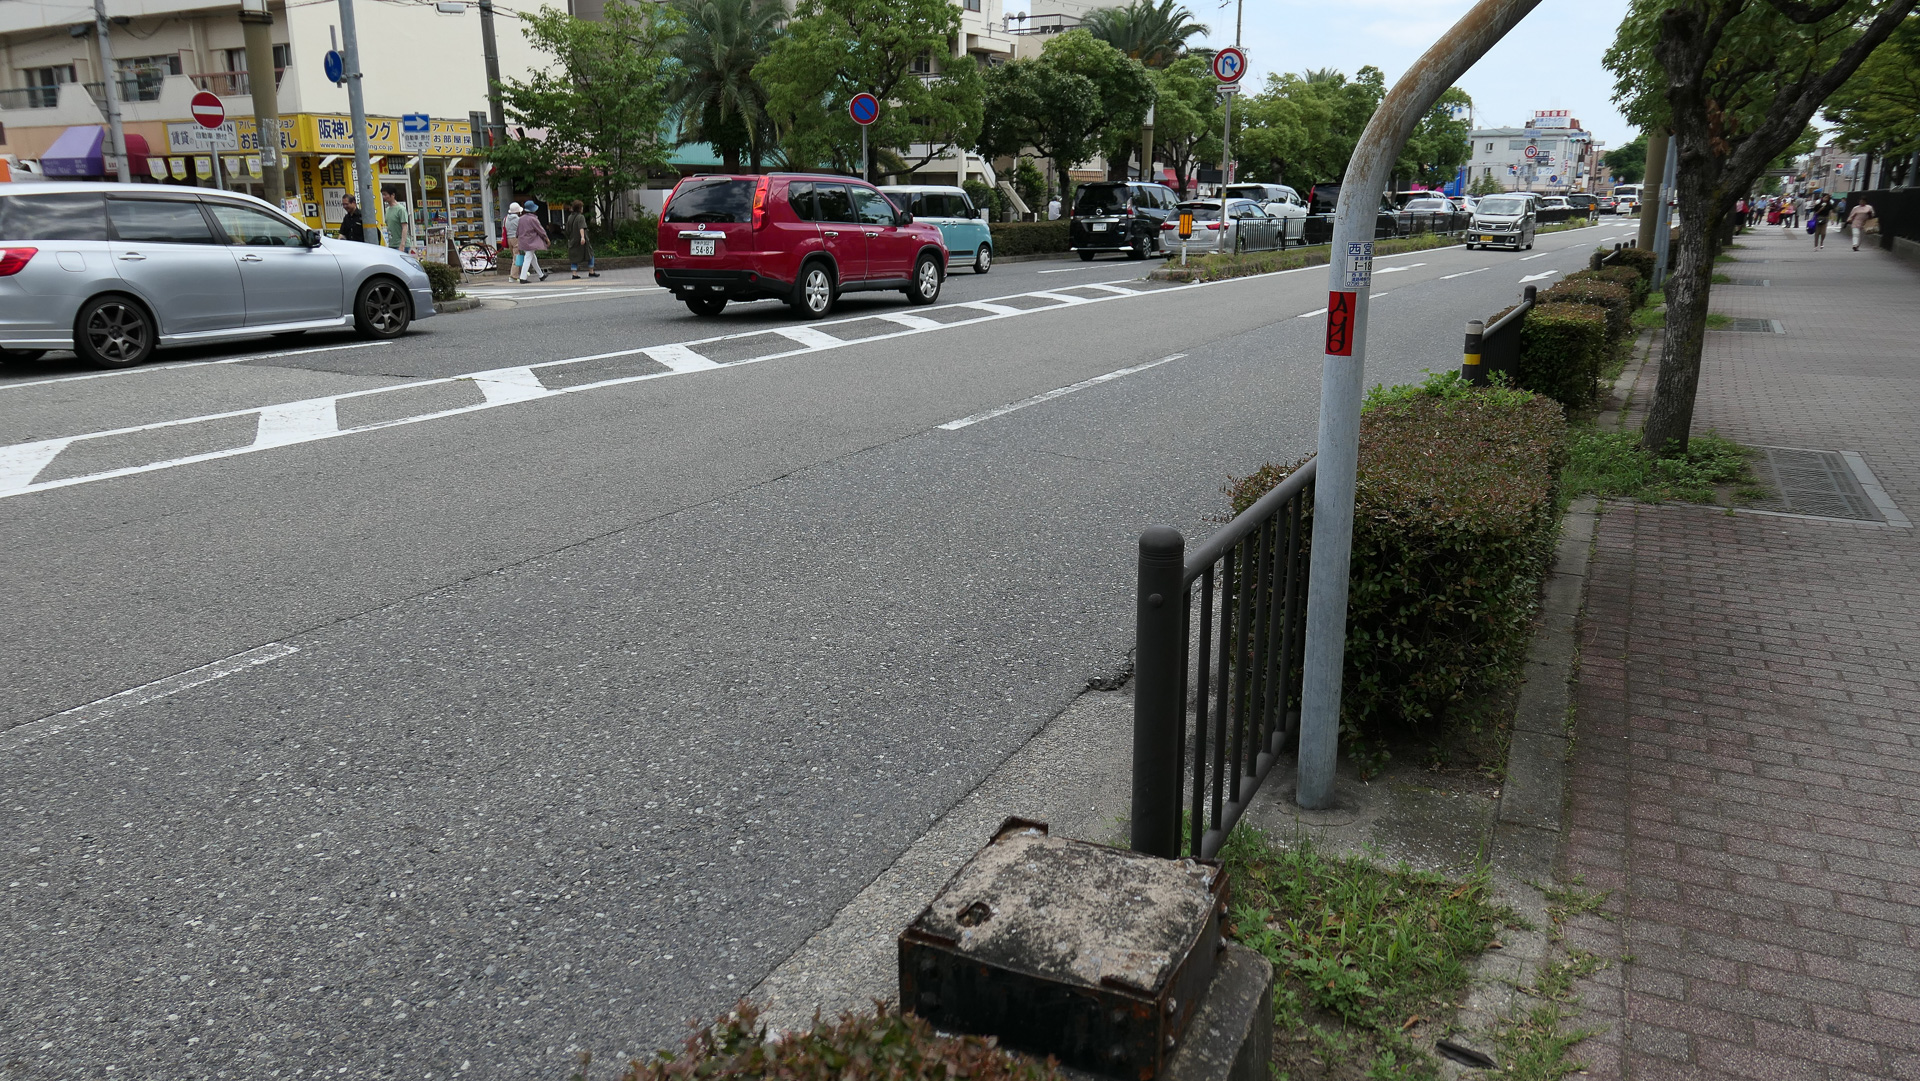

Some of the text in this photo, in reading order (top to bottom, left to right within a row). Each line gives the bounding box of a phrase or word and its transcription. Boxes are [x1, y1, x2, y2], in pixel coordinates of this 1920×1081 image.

[318, 118, 391, 140] 阪神リング
[240, 131, 297, 149] お部探し
[320, 143, 393, 151] www.hanshing.co.jp
[1349, 242, 1372, 255] 西宮
